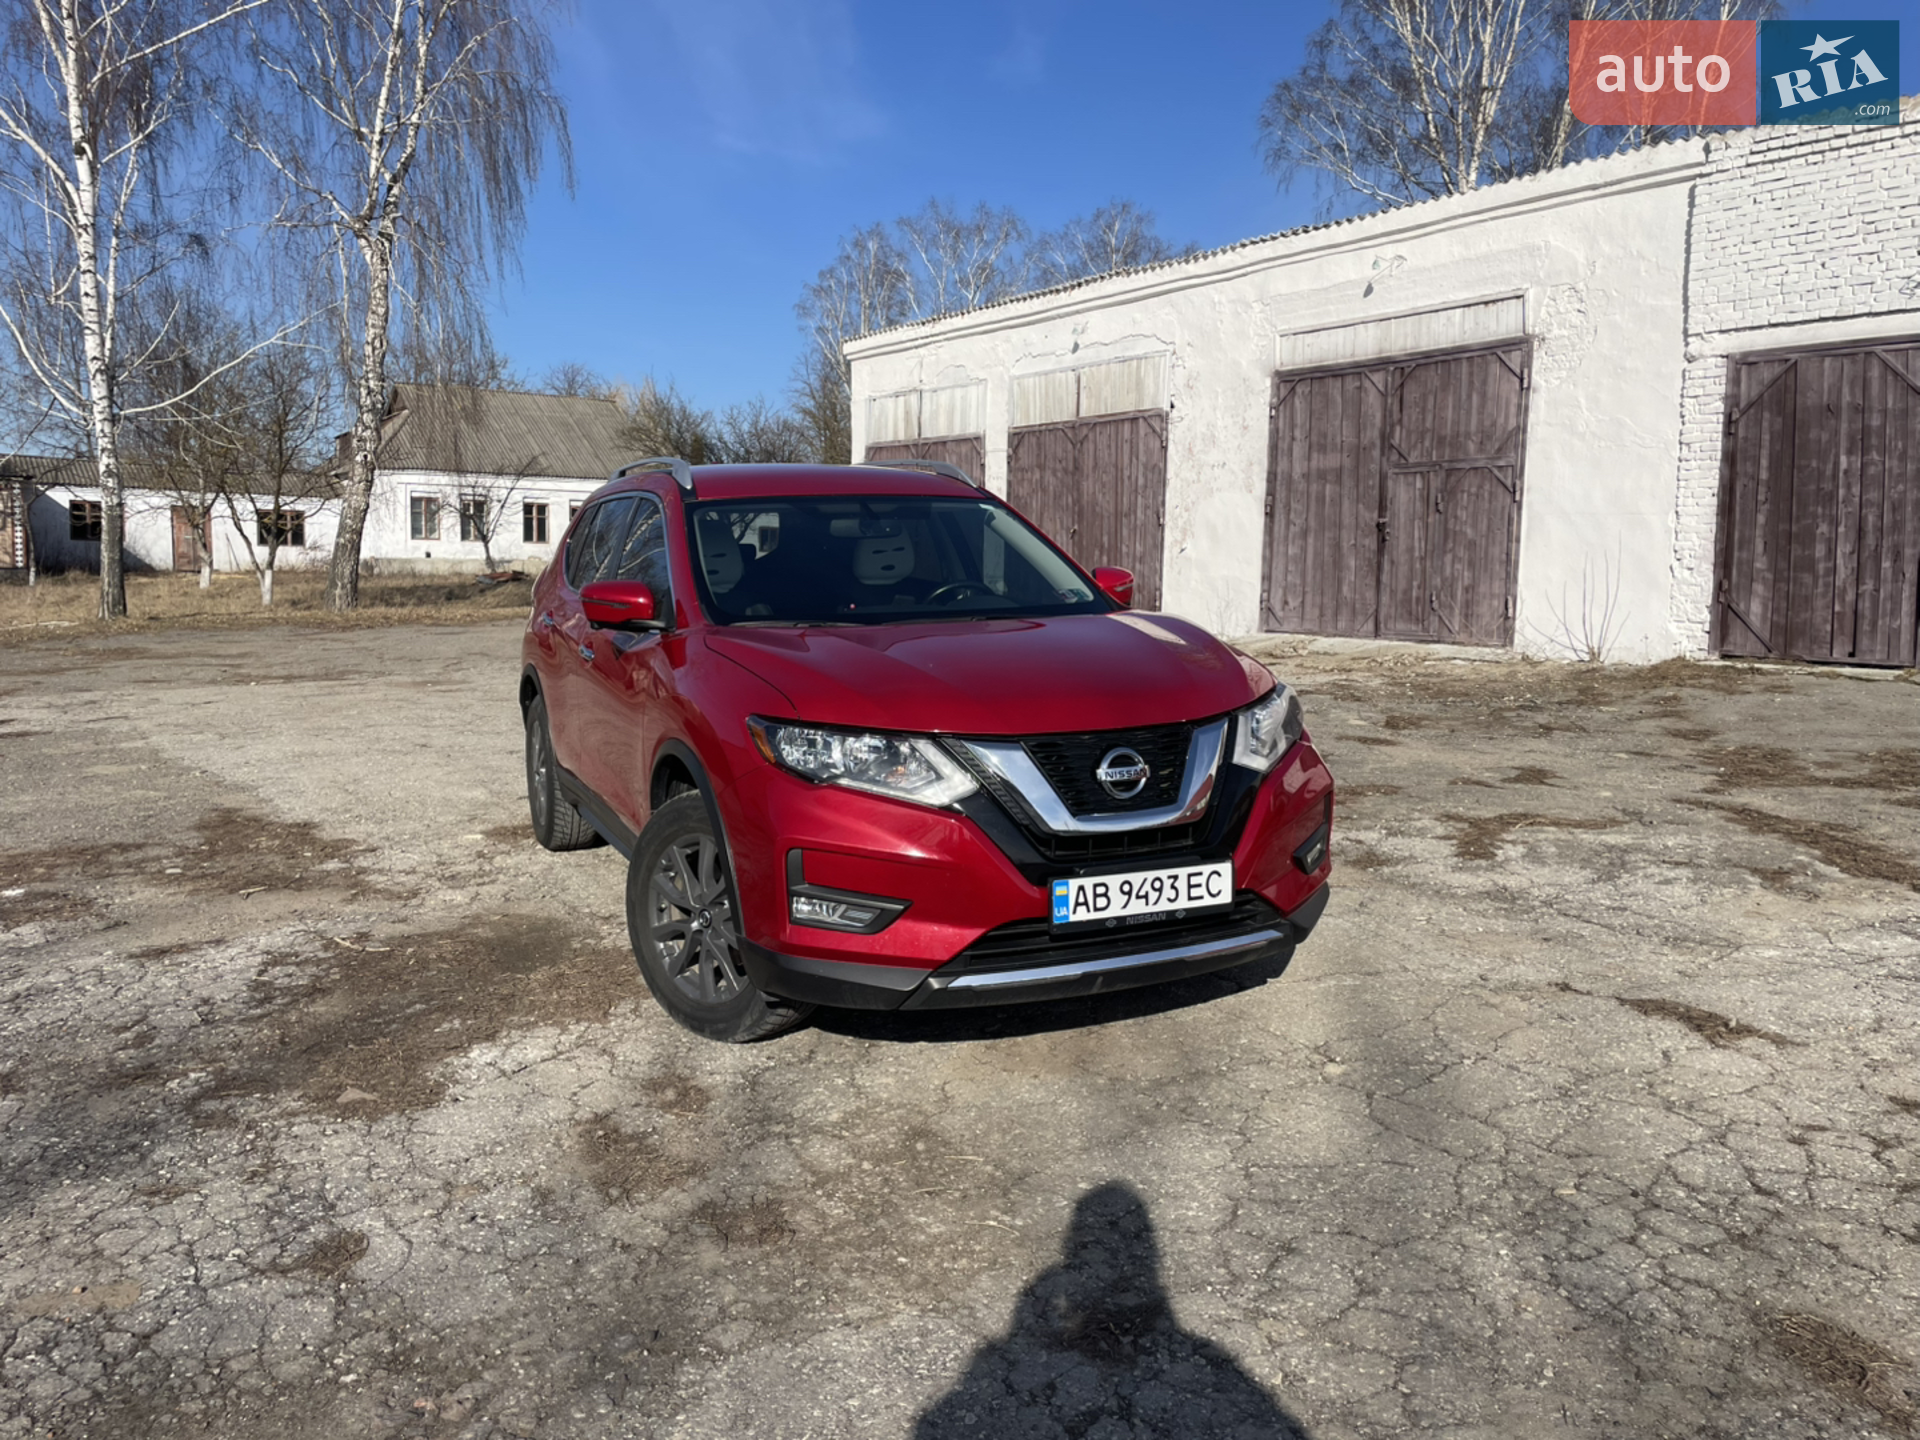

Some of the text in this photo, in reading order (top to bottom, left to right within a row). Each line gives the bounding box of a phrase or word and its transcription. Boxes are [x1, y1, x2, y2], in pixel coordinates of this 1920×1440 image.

[1105, 768, 1147, 780] NISSAN
[1072, 870, 1222, 915] AB 9493 EC
[1054, 906, 1069, 917] UA
[1126, 912, 1166, 925] NISSAN
